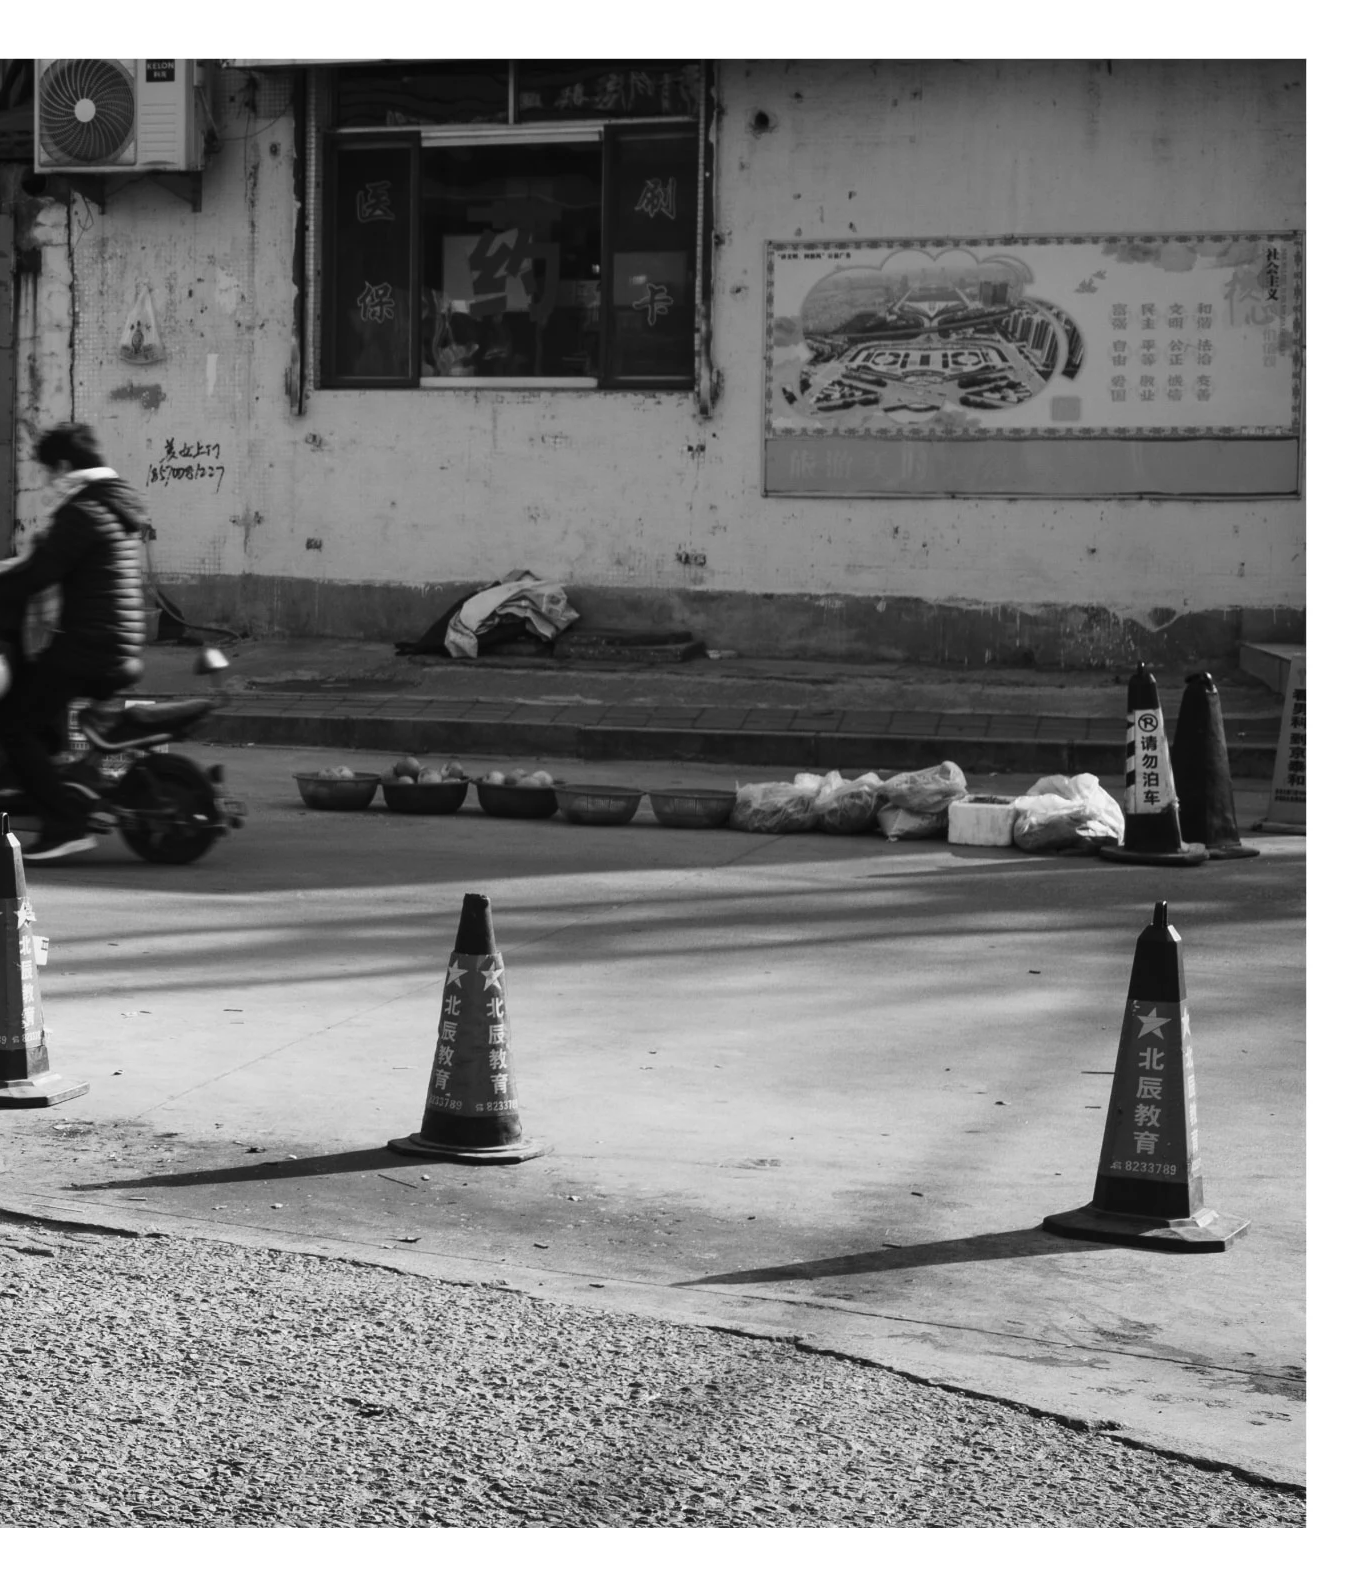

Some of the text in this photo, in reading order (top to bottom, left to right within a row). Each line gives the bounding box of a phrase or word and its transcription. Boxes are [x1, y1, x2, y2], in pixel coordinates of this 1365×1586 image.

[1265, 247, 1280, 301] 社会主义
[1140, 735, 1161, 806] 请勿泊车
[434, 994, 462, 1092] 北辰教育
[486, 997, 509, 1095] 北辰教育
[1133, 1046, 1166, 1156] 北辰教育
[1125, 1162, 1178, 1176] 8233789
